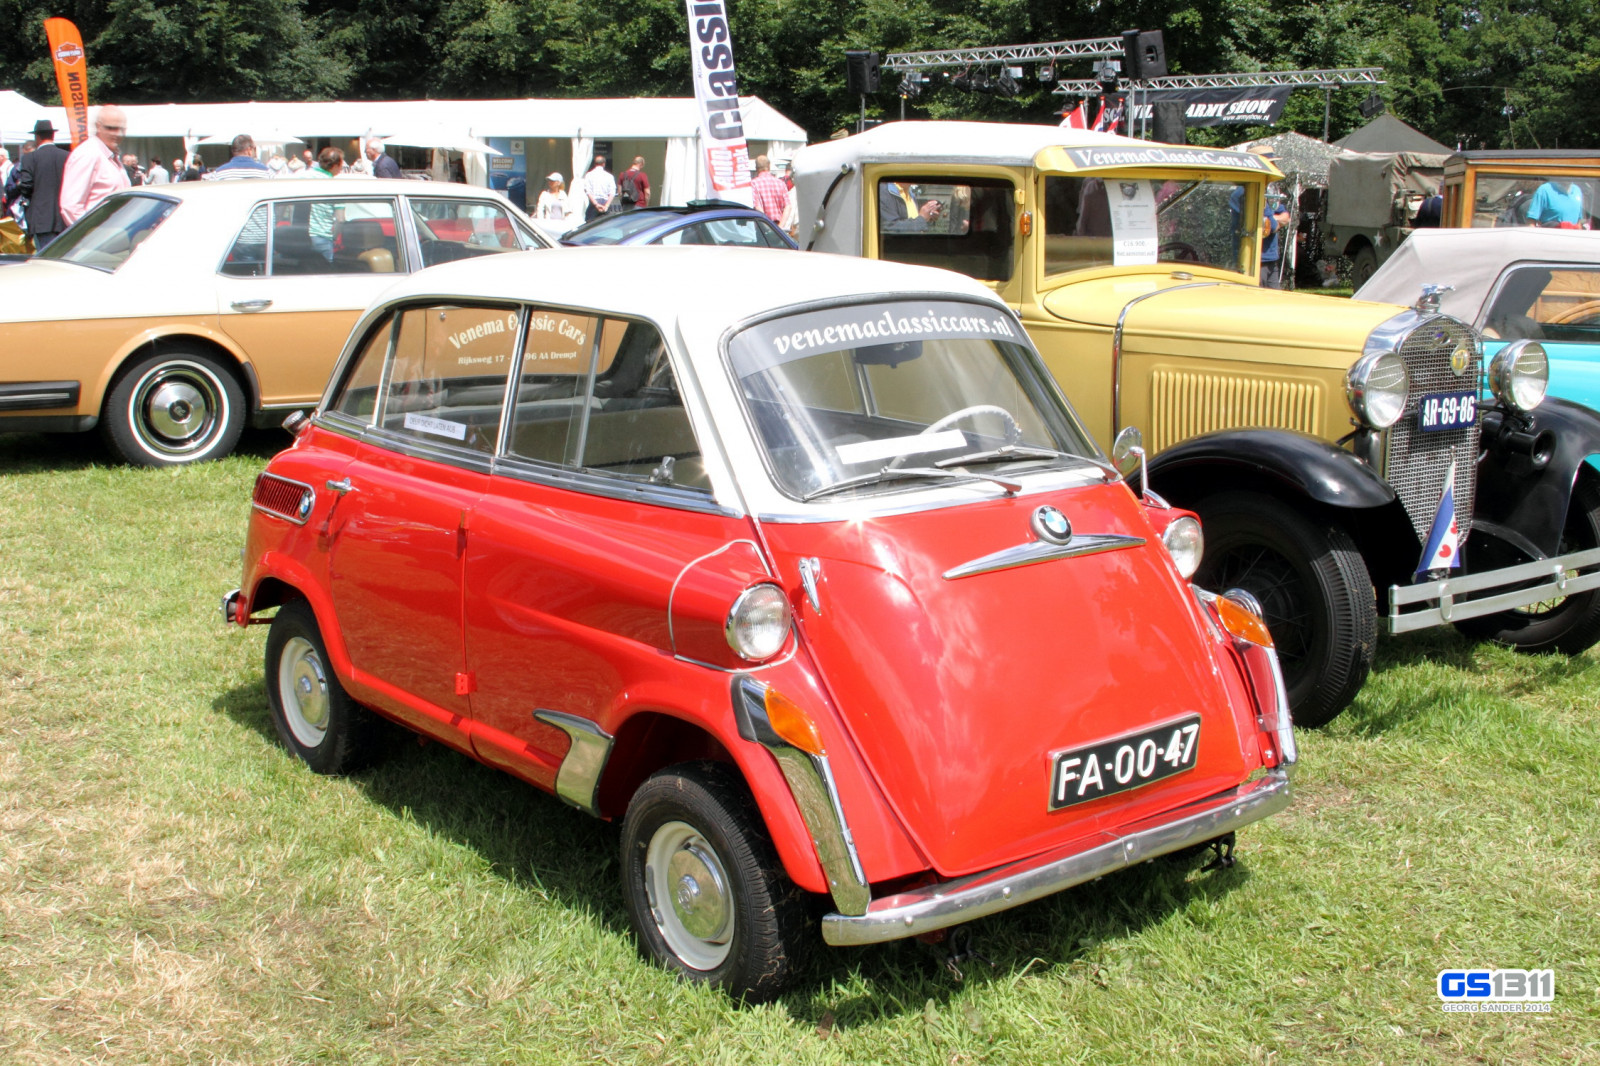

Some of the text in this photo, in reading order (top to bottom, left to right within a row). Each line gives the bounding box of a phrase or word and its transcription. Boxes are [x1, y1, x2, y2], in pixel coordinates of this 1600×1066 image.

[690, 0, 744, 140] Classi
[1185, 103, 1228, 117] ARMY
[1226, 100, 1275, 115] SHOW
[1076, 149, 1262, 169] VenemaClassicCars.nl
[448, 319, 505, 349] Venema
[558, 319, 587, 345] Cars
[773, 310, 1014, 354] venemaclassiccars.nl
[458, 356, 492, 365] Rijksweg
[1423, 396, 1475, 426] AR-69-86
[1058, 723, 1199, 800] FA-00-47
